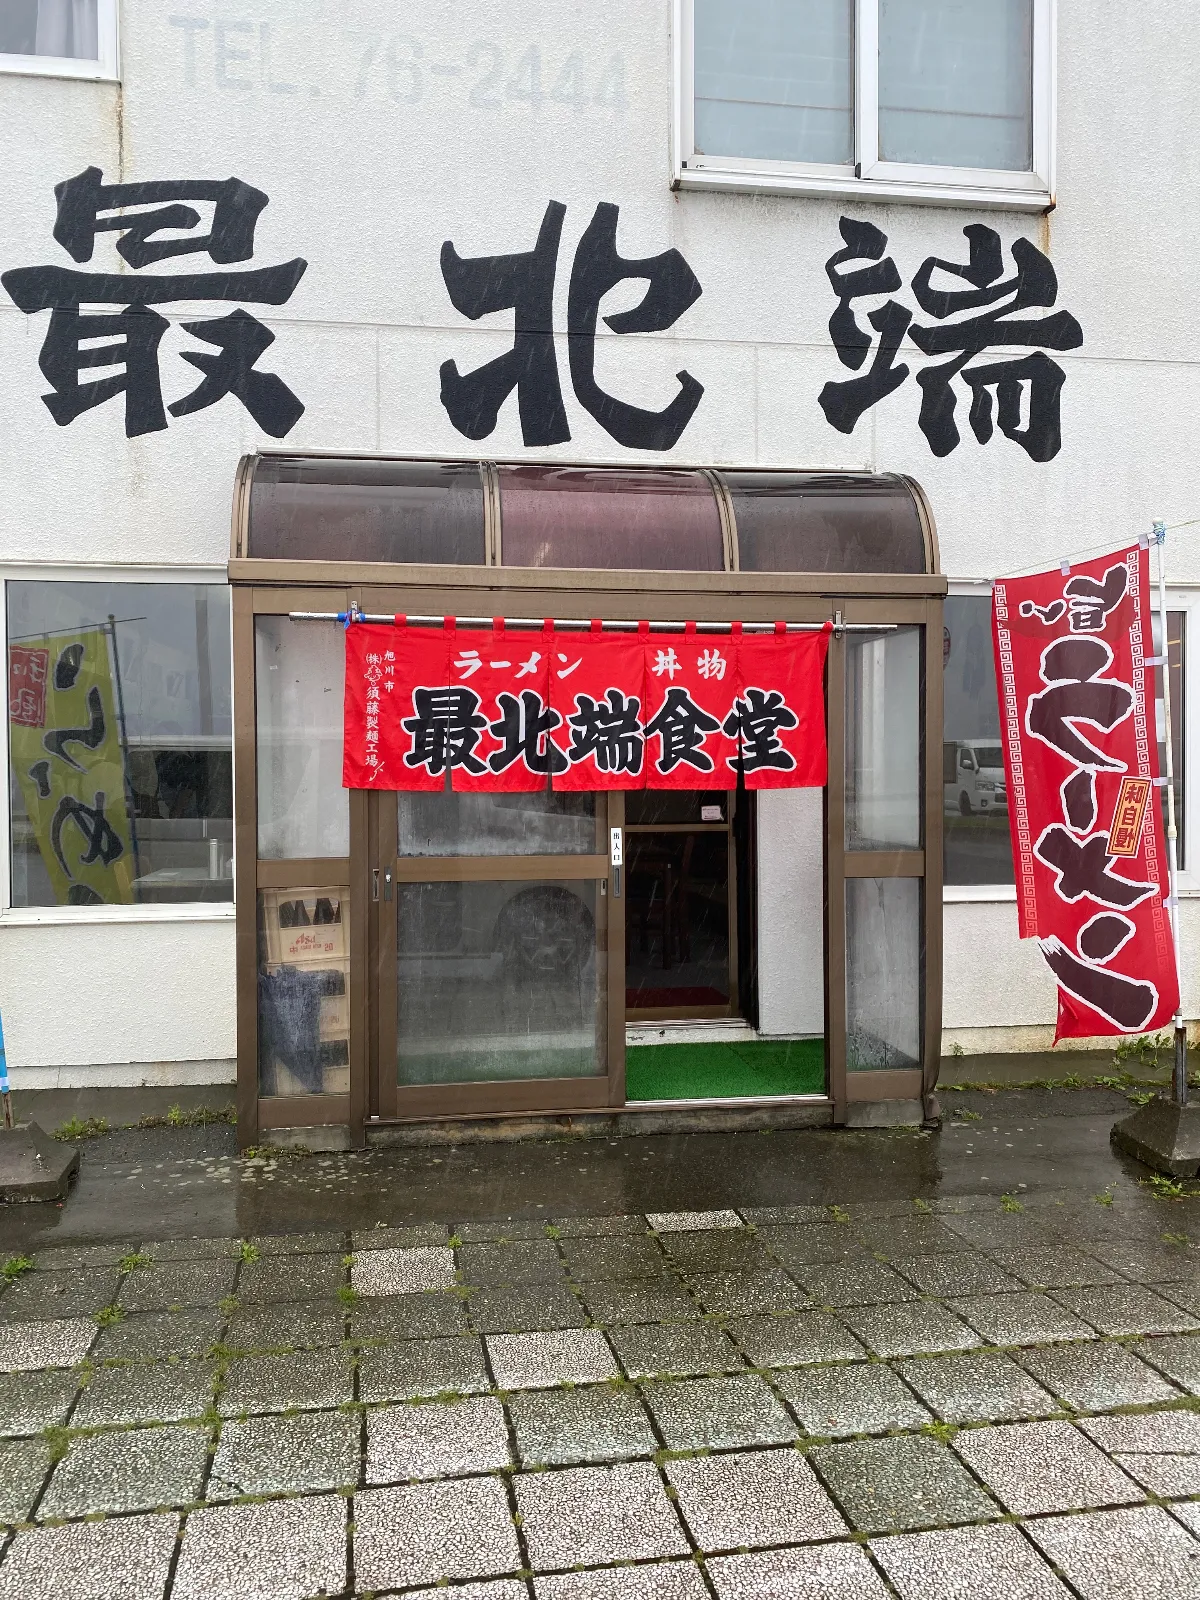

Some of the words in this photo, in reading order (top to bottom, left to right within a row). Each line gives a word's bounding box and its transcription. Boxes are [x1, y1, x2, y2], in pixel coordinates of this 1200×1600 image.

[168, 14, 321, 97] TEL.
[1, 166, 1083, 463] 最北端
[384, 650, 396, 693] 旭川市
[453, 649, 583, 681] ラーメン
[651, 647, 727, 681] 丼物
[400, 686, 799, 776] 最北端食堂
